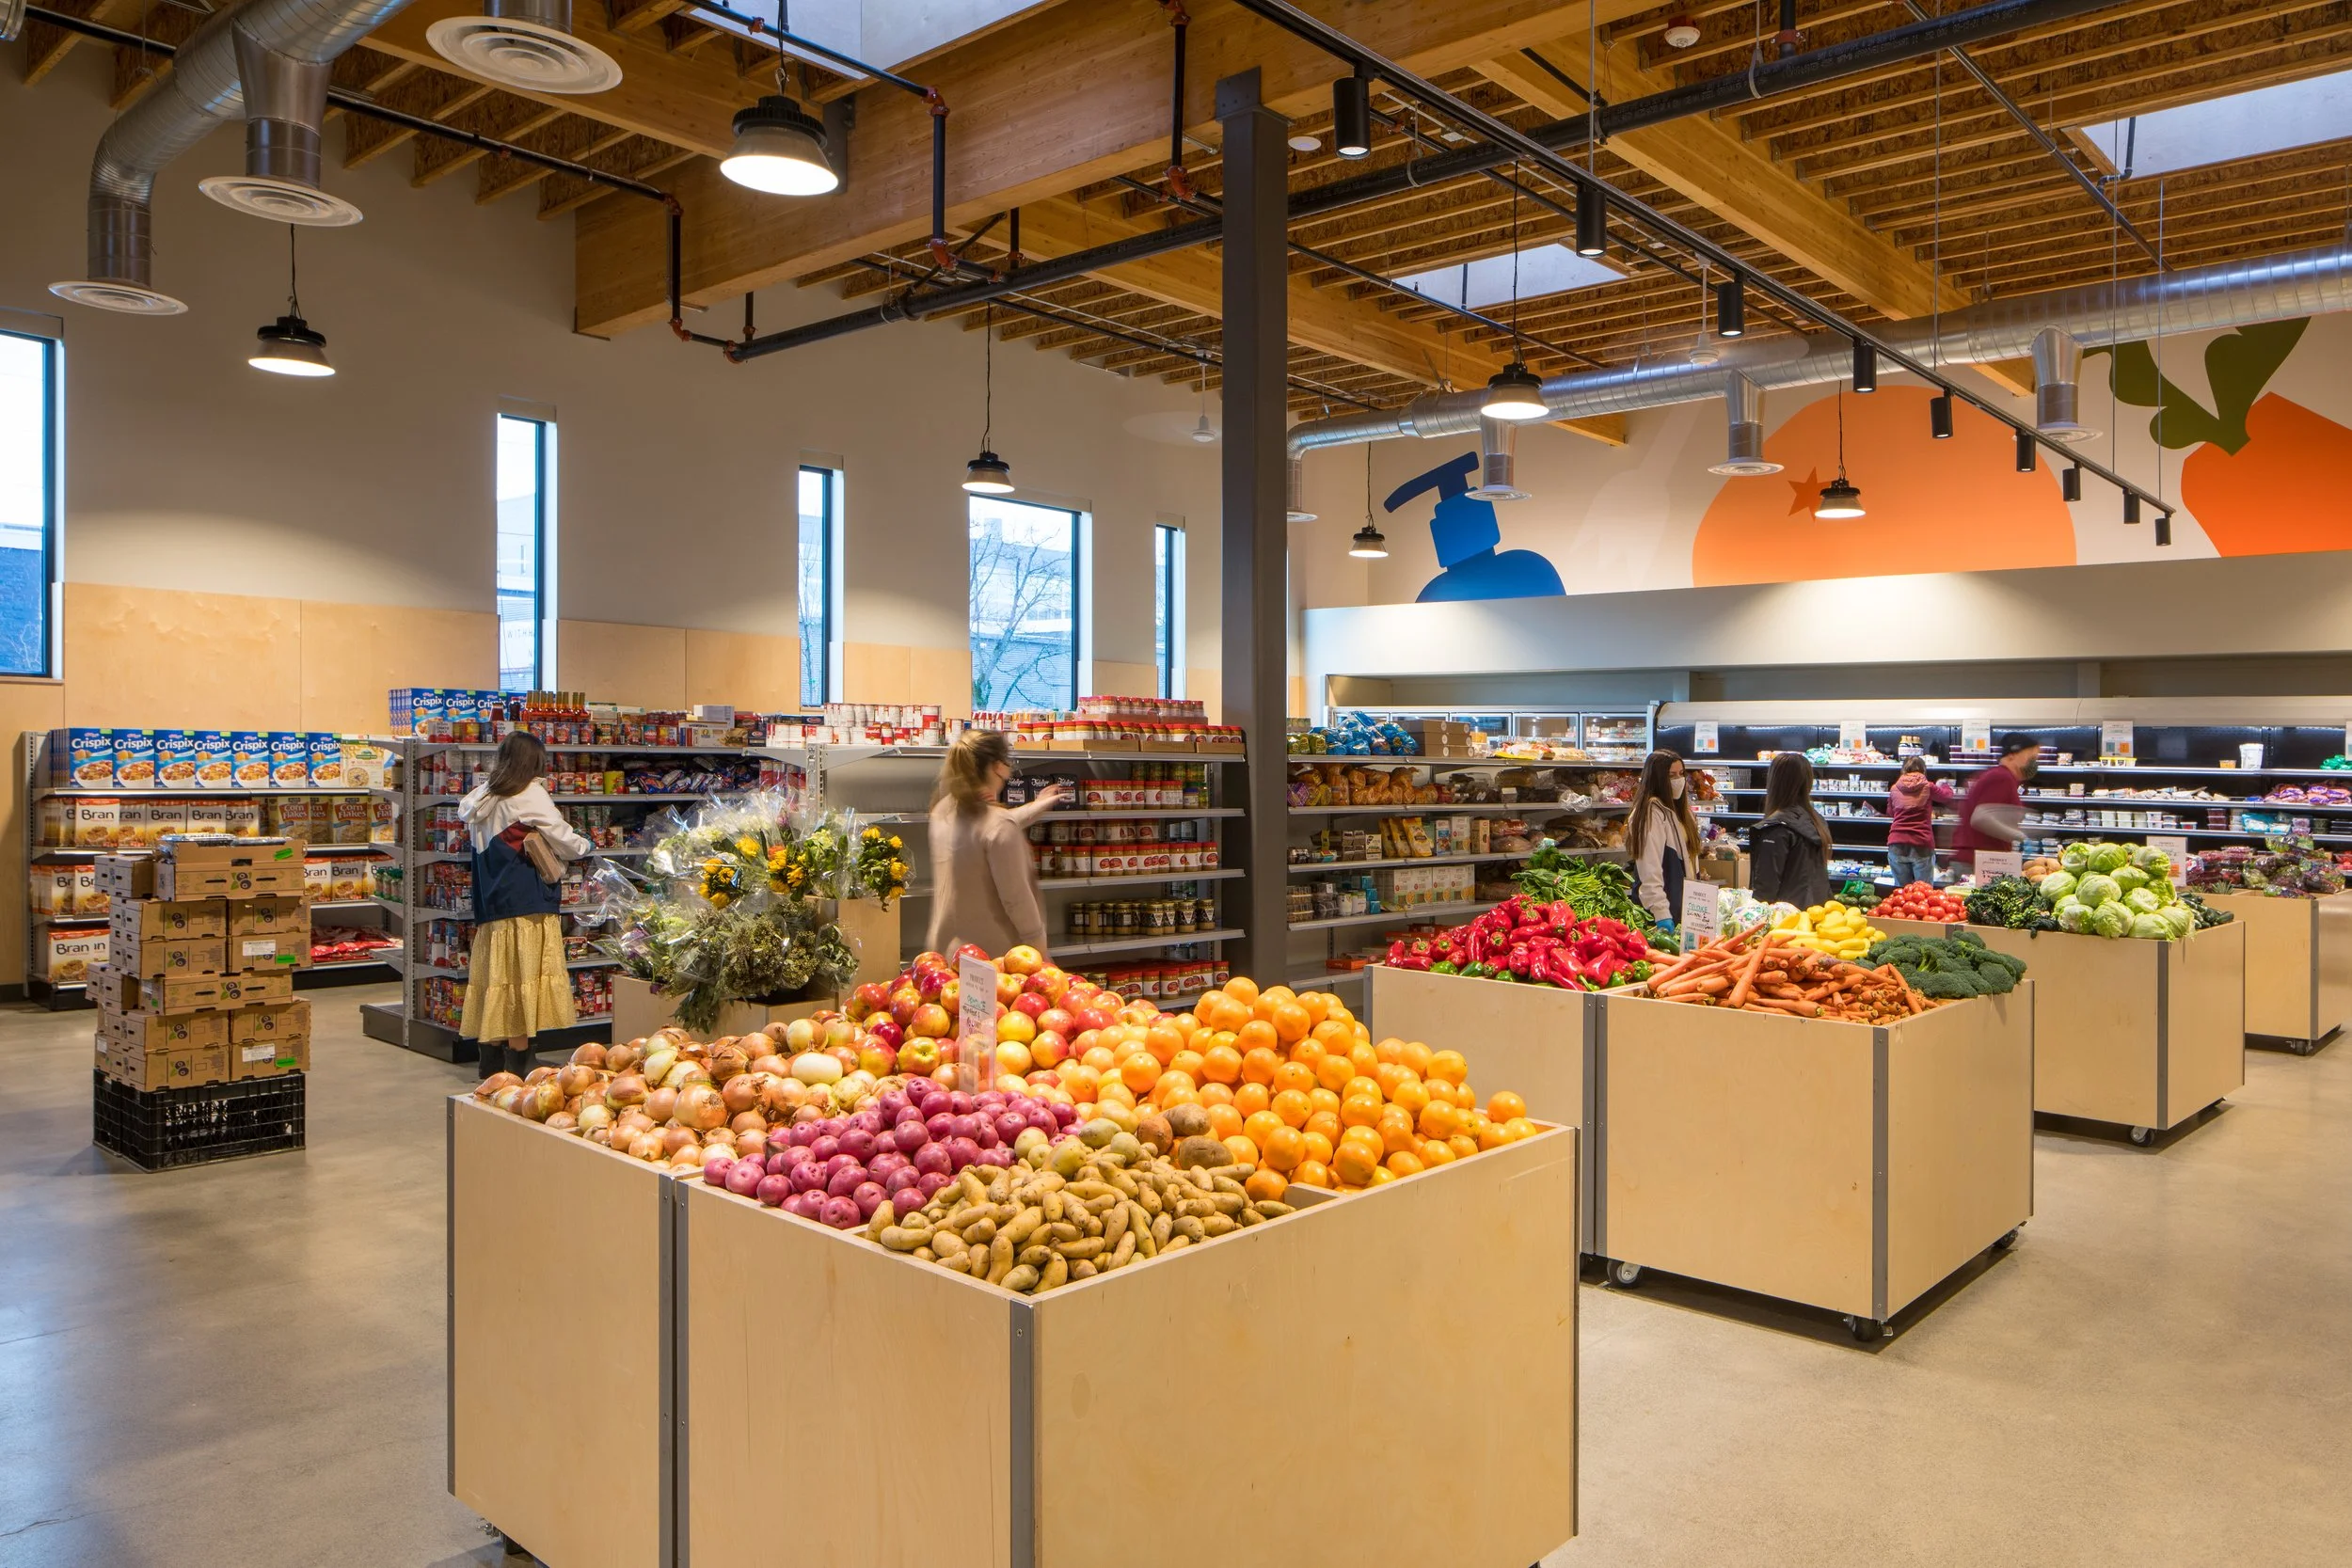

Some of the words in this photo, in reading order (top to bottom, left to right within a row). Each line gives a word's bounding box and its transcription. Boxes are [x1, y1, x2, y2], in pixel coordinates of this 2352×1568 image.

[412, 696, 443, 707] Crispix
[445, 698, 475, 708] Crispix
[72, 736, 112, 750] Crispix
[114, 736, 153, 750] Crispix
[156, 737, 194, 751] Crispix
[194, 738, 230, 752] Crispix
[232, 739, 268, 752] Crispix
[270, 739, 305, 752] Crispix
[310, 739, 341, 752] Crispix
[81, 809, 115, 820] Bran
[119, 810, 142, 819] ran
[151, 810, 182, 821] Bran
[192, 810, 222, 821] Bran
[226, 811, 254, 821] Bran
[282, 811, 307, 819] Flakes
[332, 866, 358, 877] Bran
[56, 877, 73, 888] Br
[80, 876, 94, 887] Br
[56, 943, 89, 956] Bran
